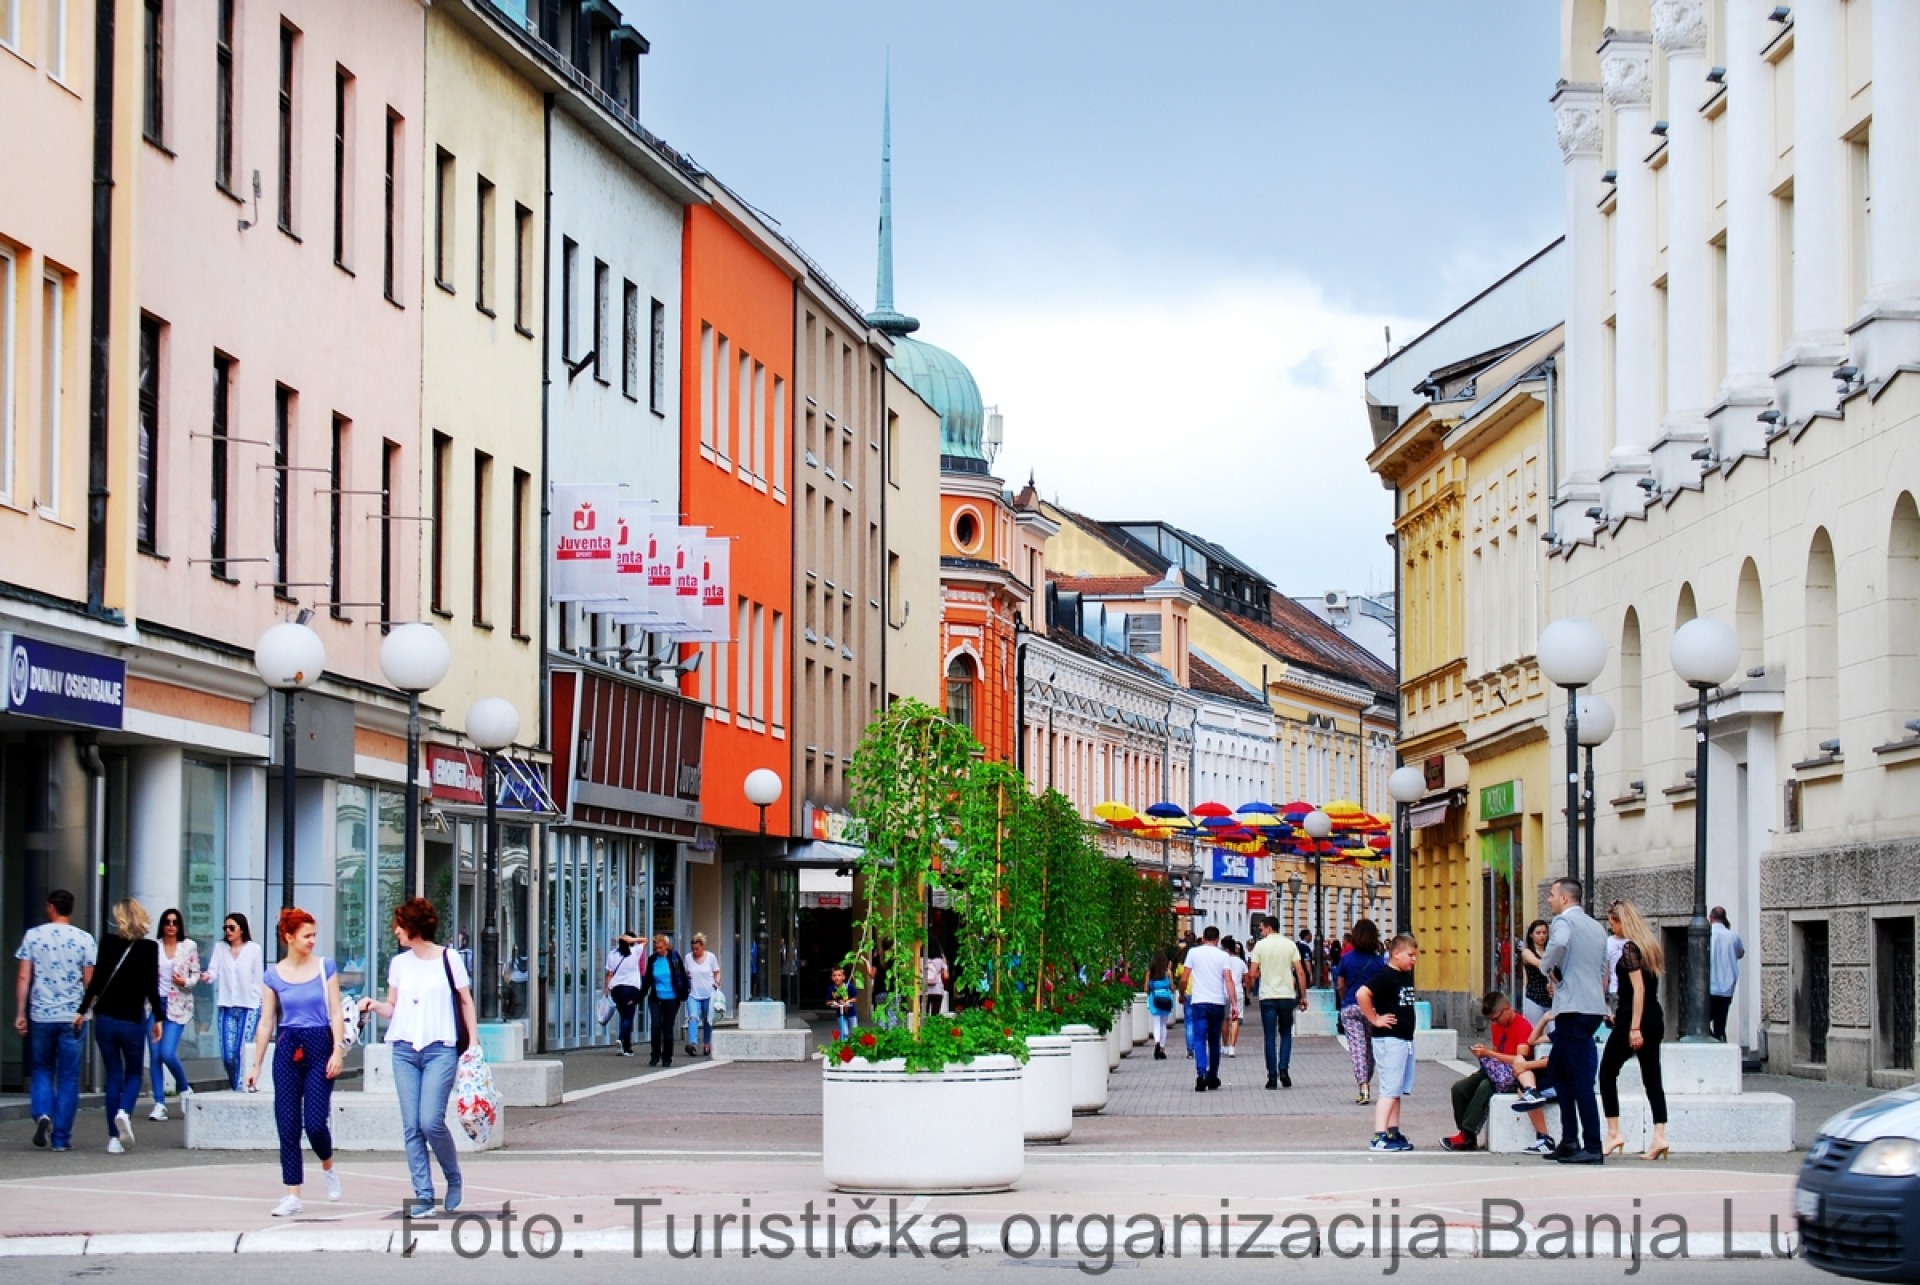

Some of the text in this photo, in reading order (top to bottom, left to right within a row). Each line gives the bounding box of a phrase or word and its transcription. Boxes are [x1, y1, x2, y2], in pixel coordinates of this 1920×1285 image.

[557, 535, 611, 550] Juventa
[29, 665, 122, 706] DUNAV OSIGURANJE
